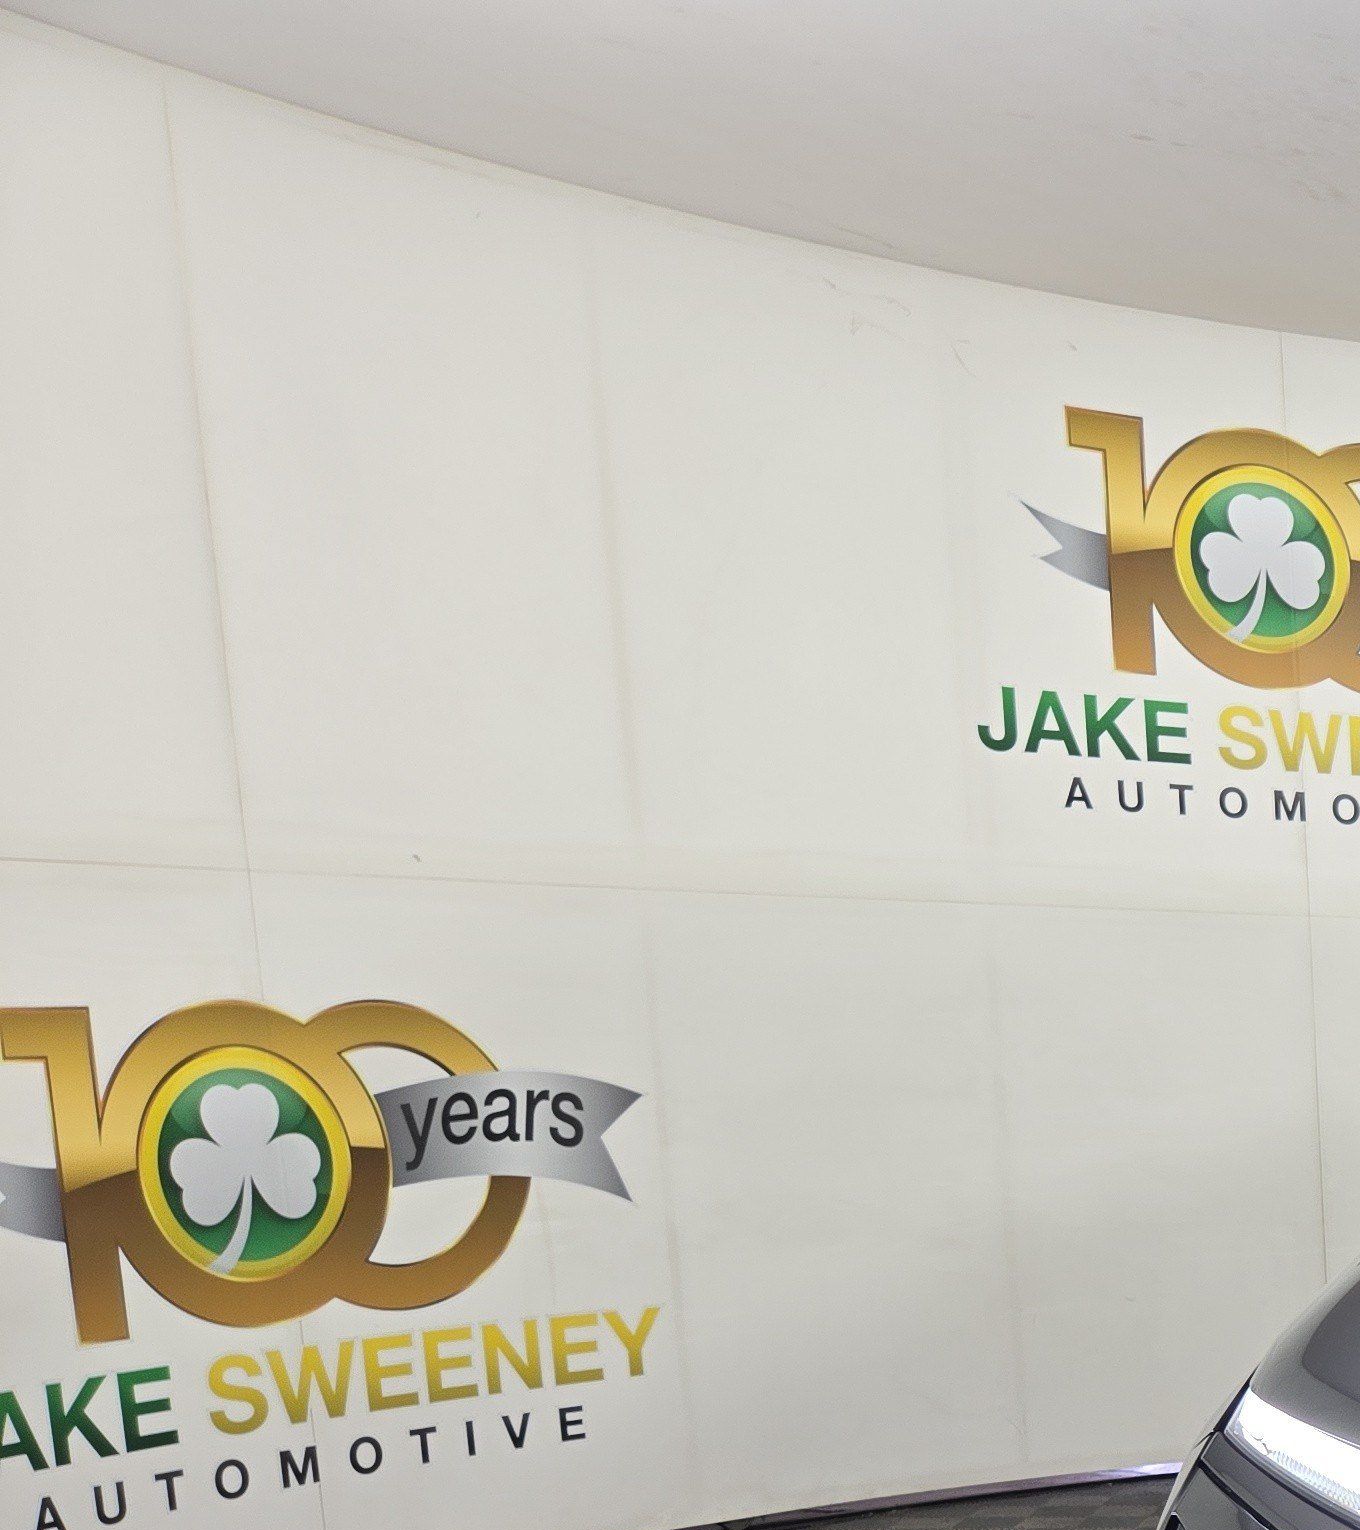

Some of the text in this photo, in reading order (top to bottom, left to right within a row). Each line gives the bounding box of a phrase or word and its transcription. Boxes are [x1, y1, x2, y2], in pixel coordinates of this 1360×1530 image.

[977, 685, 1192, 765] JAKE
[0, 999, 531, 1346] 100
[400, 1087, 585, 1171] years
[207, 1306, 661, 1436] SWEENEY
